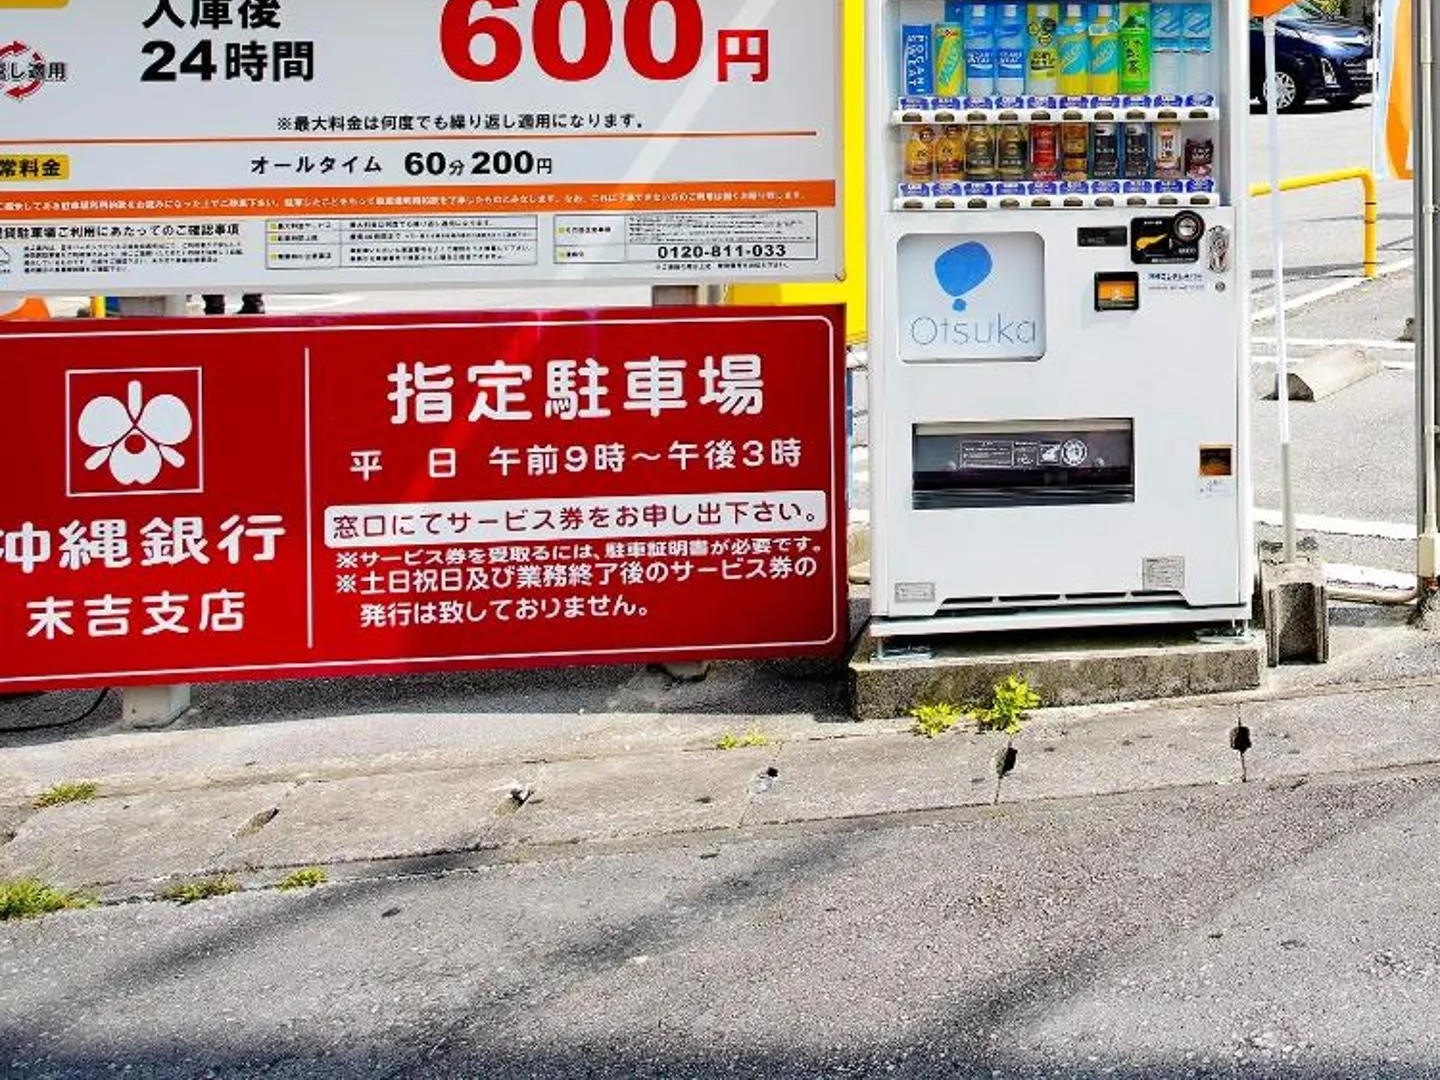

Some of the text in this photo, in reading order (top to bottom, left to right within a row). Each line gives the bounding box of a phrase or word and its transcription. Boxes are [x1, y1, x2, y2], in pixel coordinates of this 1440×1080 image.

[141, 39, 314, 82] 24時間
[251, 154, 383, 175] オールタイム
[658, 243, 787, 259] 0120-811-033
[910, 312, 1037, 346] Otsuka
[387, 353, 766, 425] 指定駐車場
[332, 500, 818, 539] 窓口にてサービス券をお申し出下さい。
[336, 556, 818, 595] ※土日祝日及び業務終了後のサービス券の
[26, 588, 246, 640] 末吉支店
[359, 594, 650, 629] 発行は致しておりません。
